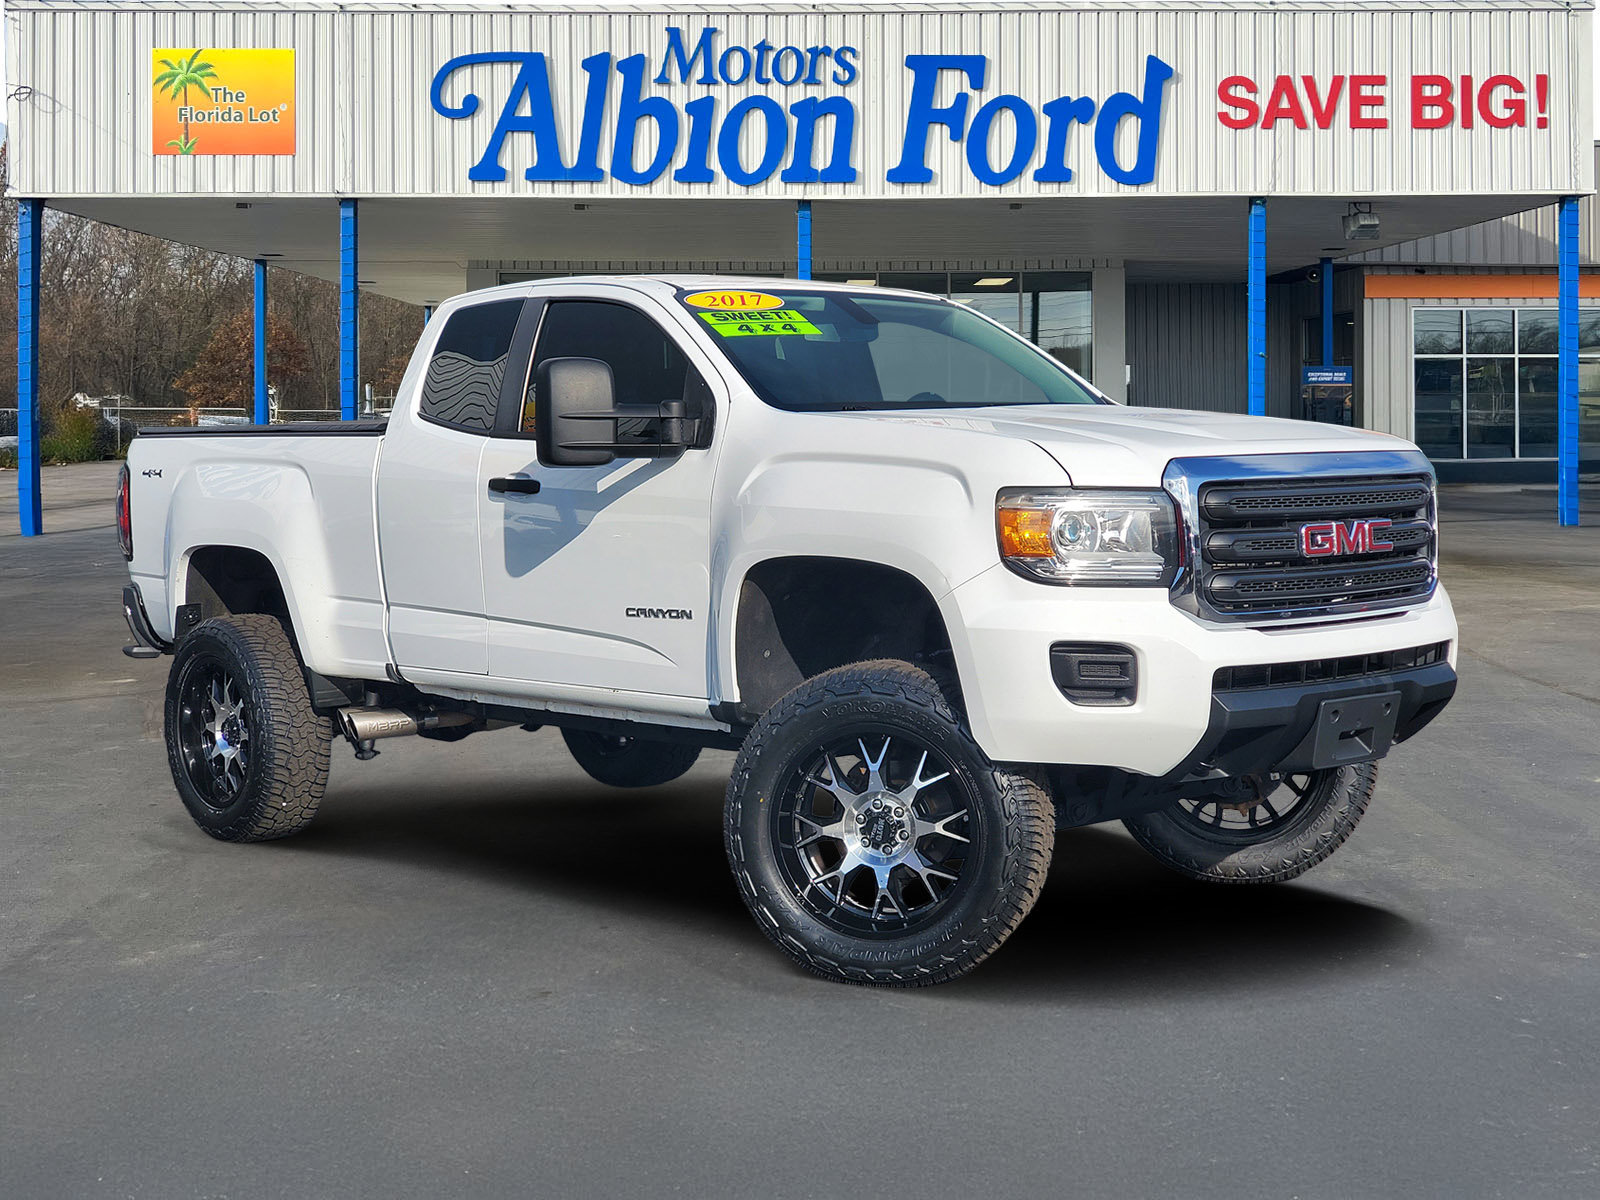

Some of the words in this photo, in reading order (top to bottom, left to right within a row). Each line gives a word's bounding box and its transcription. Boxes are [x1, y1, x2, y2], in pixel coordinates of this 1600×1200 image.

[653, 27, 857, 86] Motors
[211, 87, 246, 103] The
[1217, 75, 1388, 129] SAVE
[1411, 75, 1549, 129] BIG!
[178, 107, 244, 122] Florida
[249, 107, 280, 122] Lot
[430, 52, 857, 187] Albion
[886, 54, 1175, 187] Ford
[704, 294, 762, 307] 2017
[711, 311, 793, 322] SWEET!
[1301, 518, 1395, 558] GMC
[625, 607, 694, 620] CANYON
[366, 718, 411, 733] MBRP
[875, 817, 886, 841] MOTO
